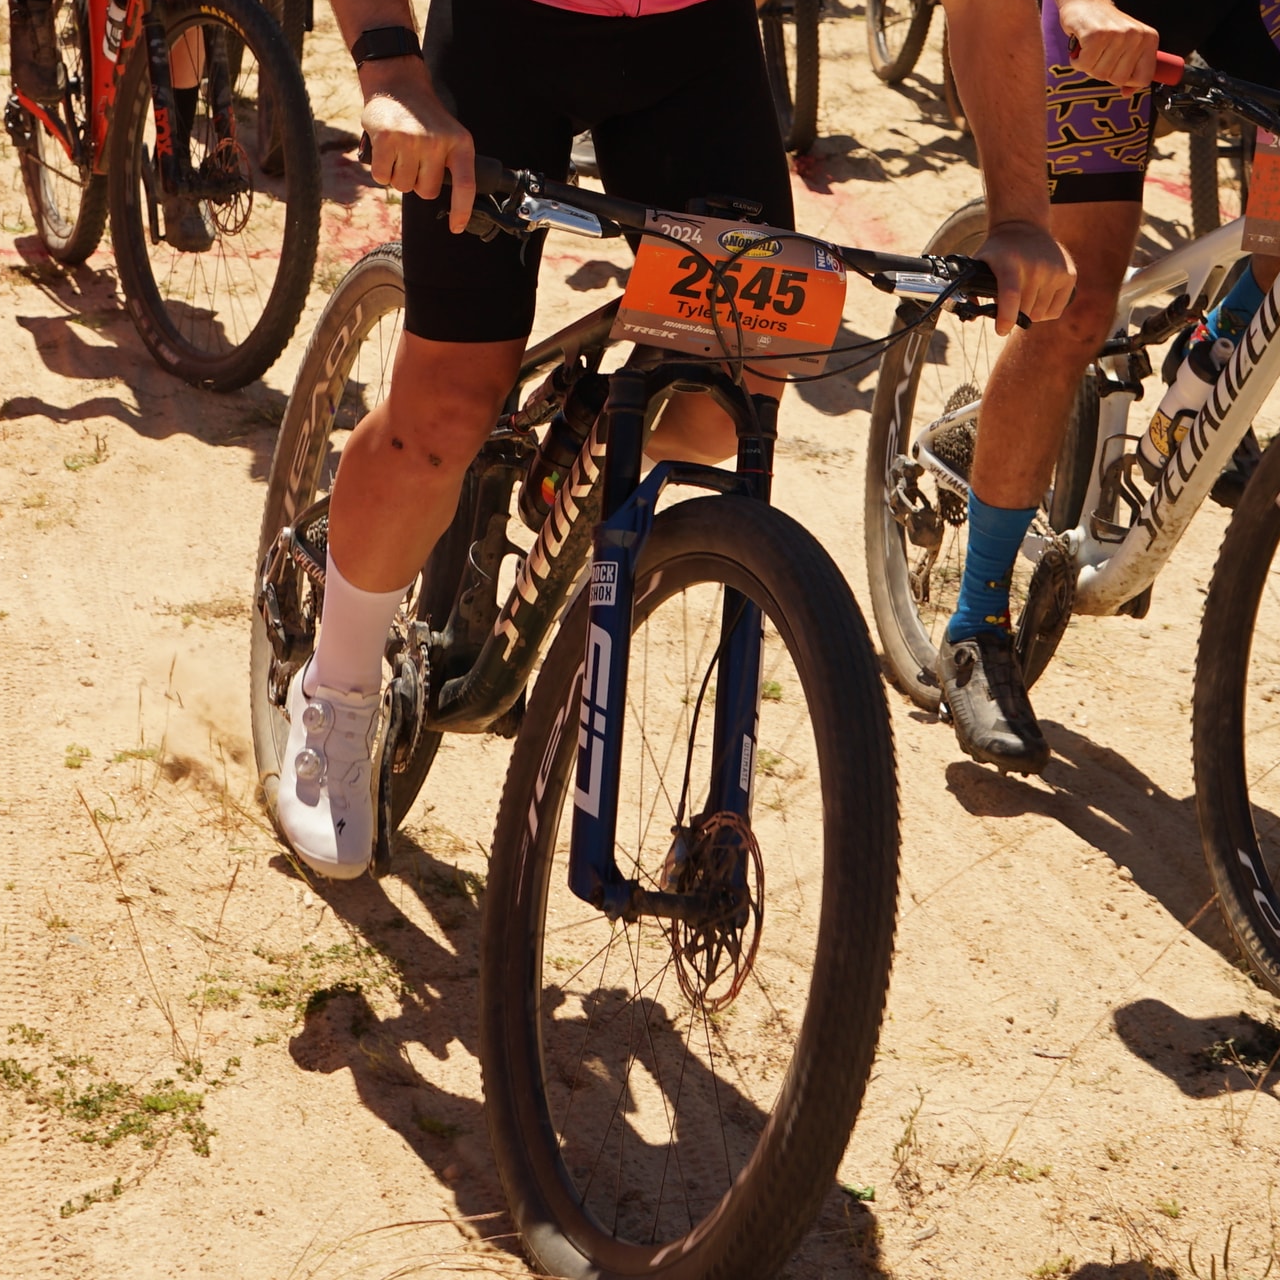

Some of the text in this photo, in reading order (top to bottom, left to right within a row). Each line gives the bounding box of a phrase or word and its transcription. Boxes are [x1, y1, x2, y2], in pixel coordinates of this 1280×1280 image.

[660, 223, 704, 244] 2024
[669, 255, 809, 316] 2545
[677, 300, 722, 320] Tyler
[622, 323, 679, 340] TREK
[929, 411, 957, 433] EPIC
[1137, 287, 1280, 552] SPECIALIZED
[591, 563, 616, 583] ROCK
[589, 585, 615, 605] SHOX
[741, 739, 752, 786] ULTIMATE
